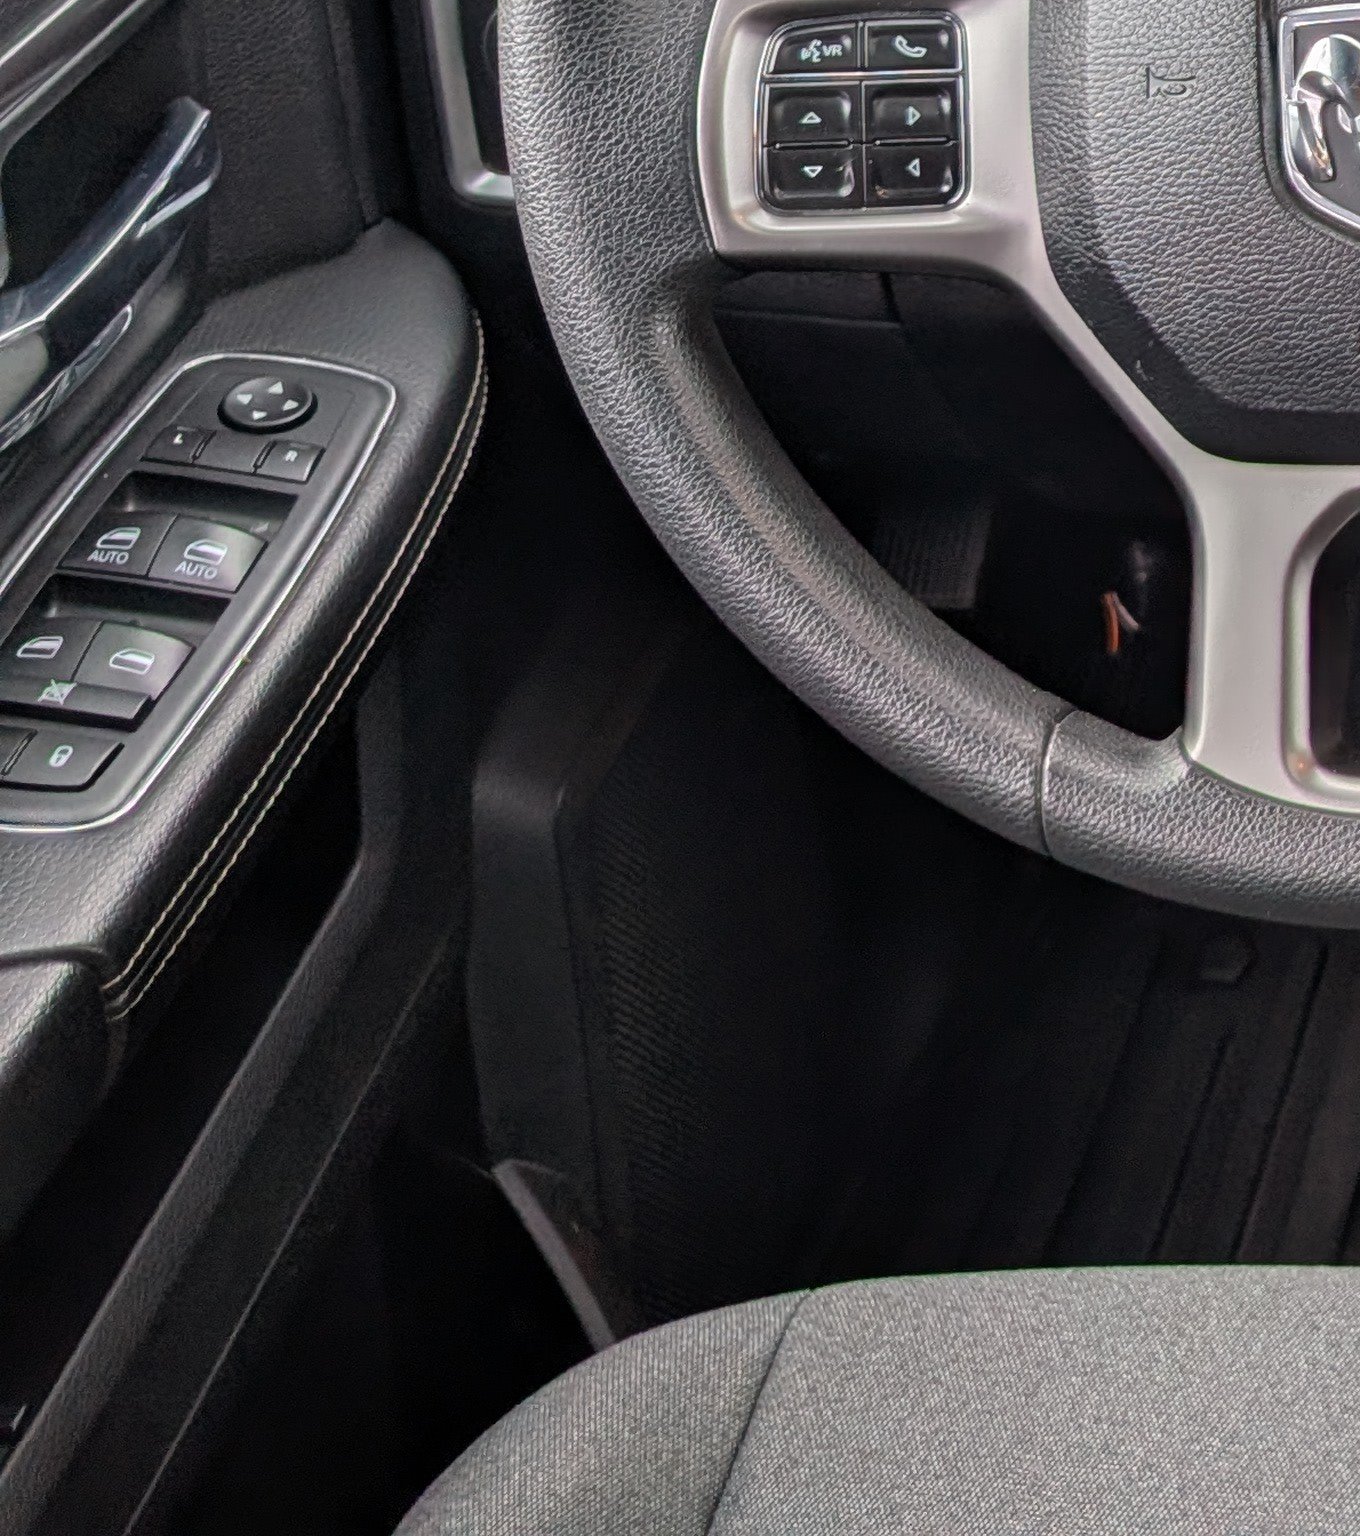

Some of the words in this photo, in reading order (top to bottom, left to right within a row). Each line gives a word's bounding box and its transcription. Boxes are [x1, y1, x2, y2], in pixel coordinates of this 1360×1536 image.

[823, 43, 843, 57] VR
[87, 549, 130, 565] AUTO
[174, 560, 219, 580] AUTO
